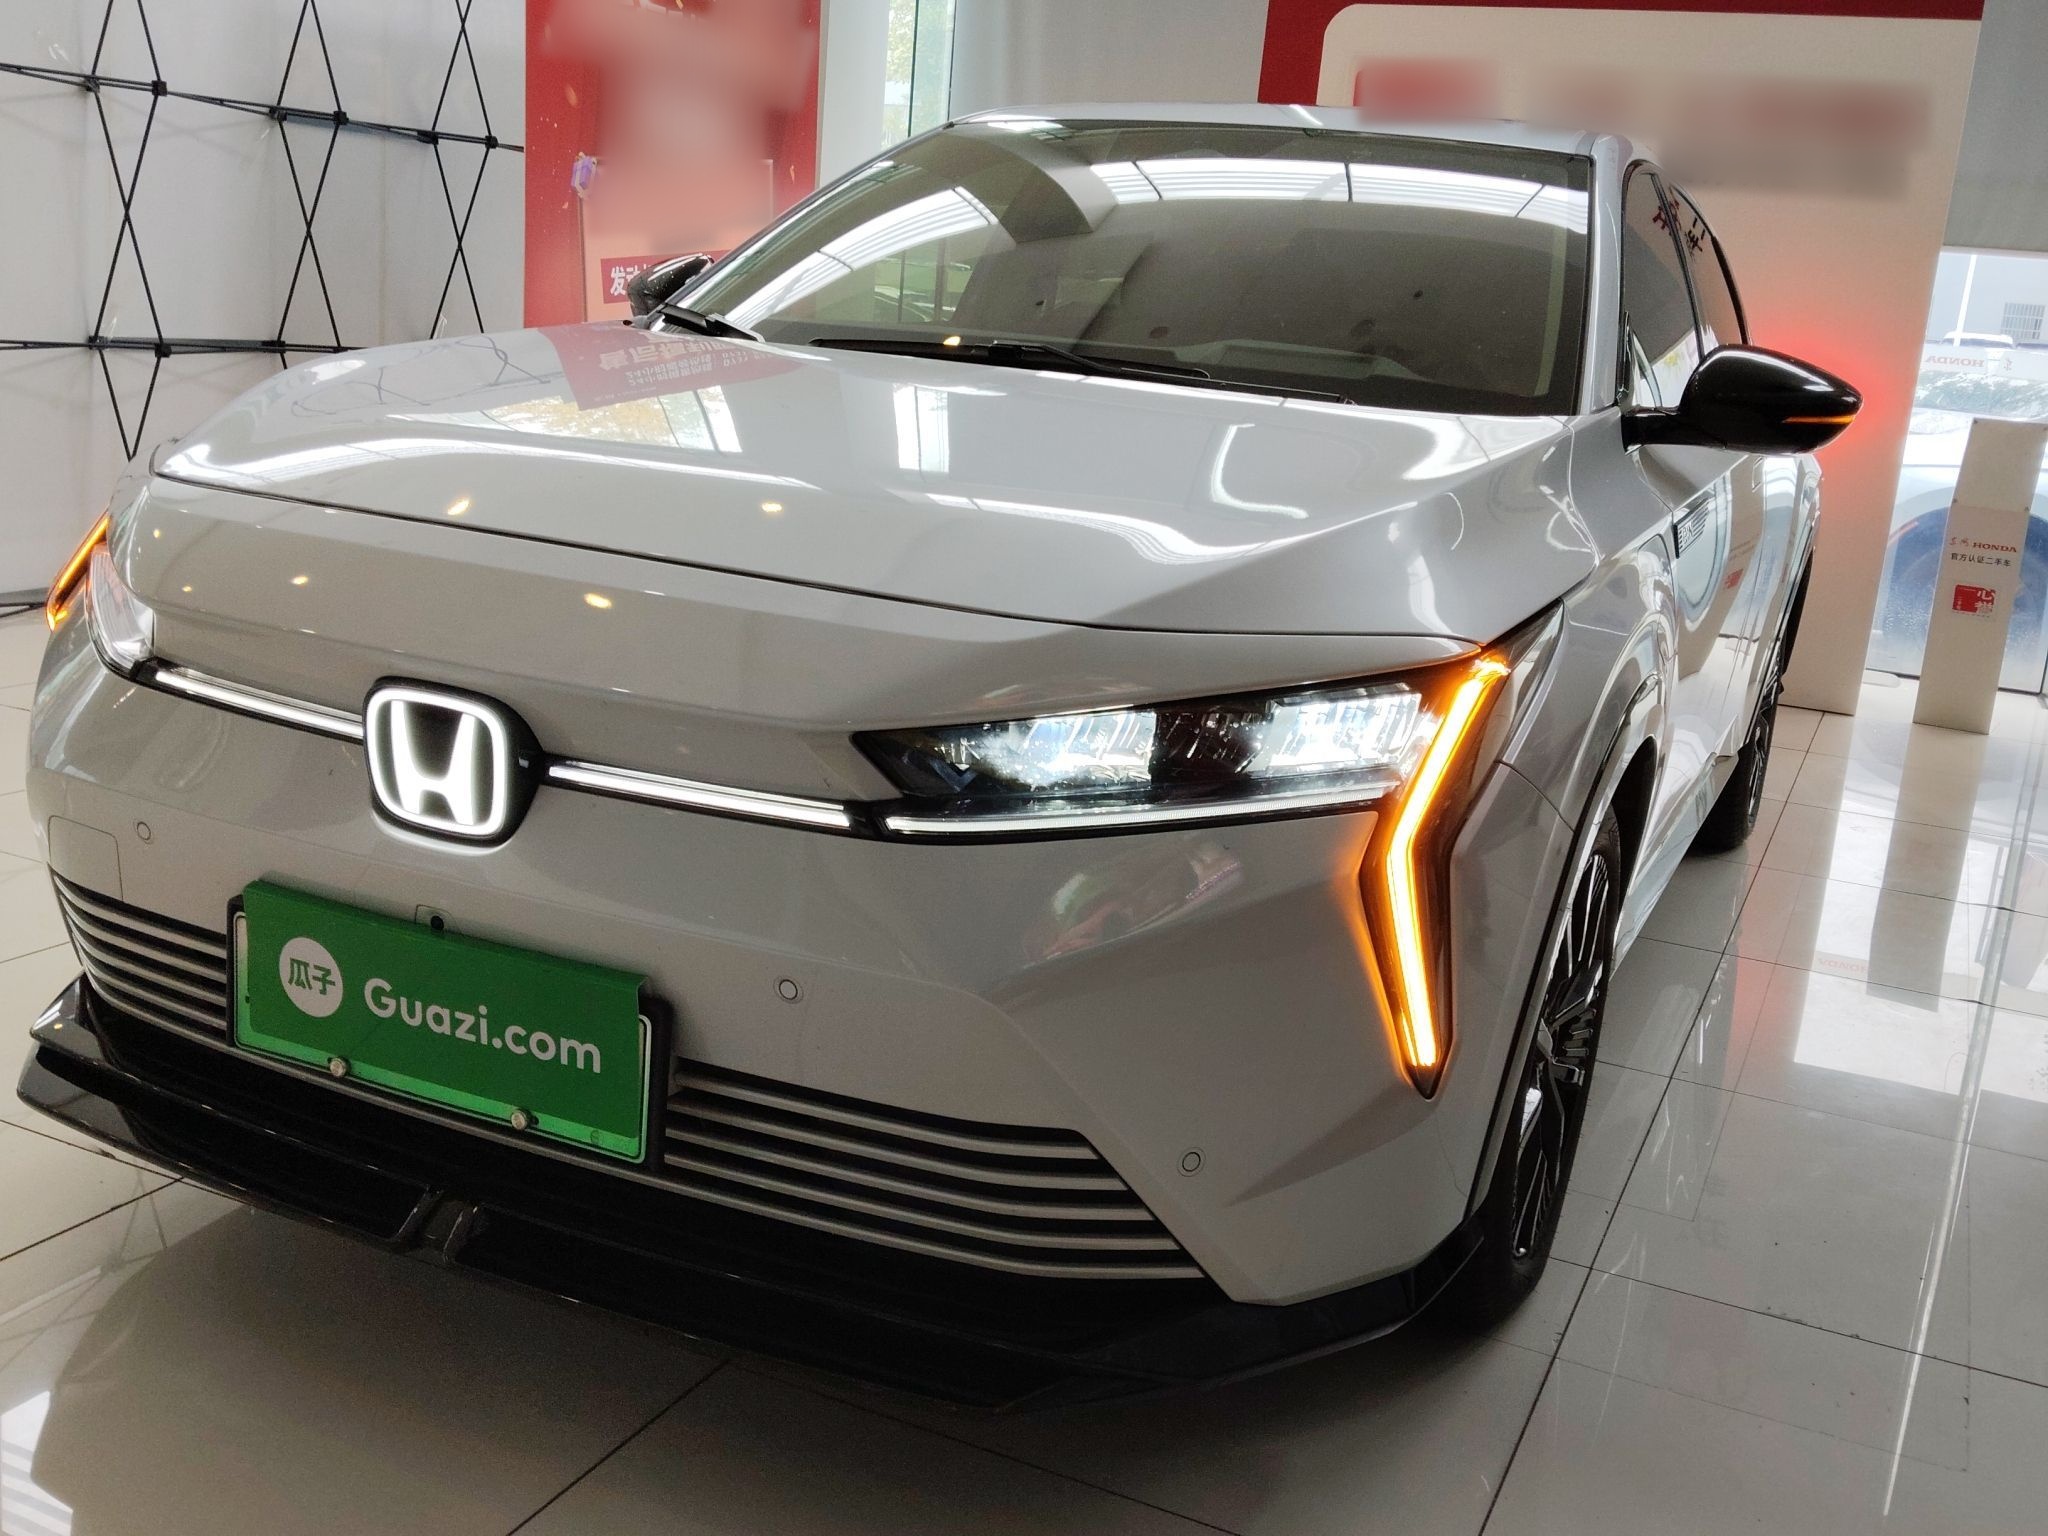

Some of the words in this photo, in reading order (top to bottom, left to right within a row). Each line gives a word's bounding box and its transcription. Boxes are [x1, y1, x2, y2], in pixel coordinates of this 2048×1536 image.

[610, 263, 653, 297] 发动
[1972, 542, 2017, 553] HONDA
[288, 957, 336, 996] 瓜子
[364, 977, 601, 1074] Guazi.com
